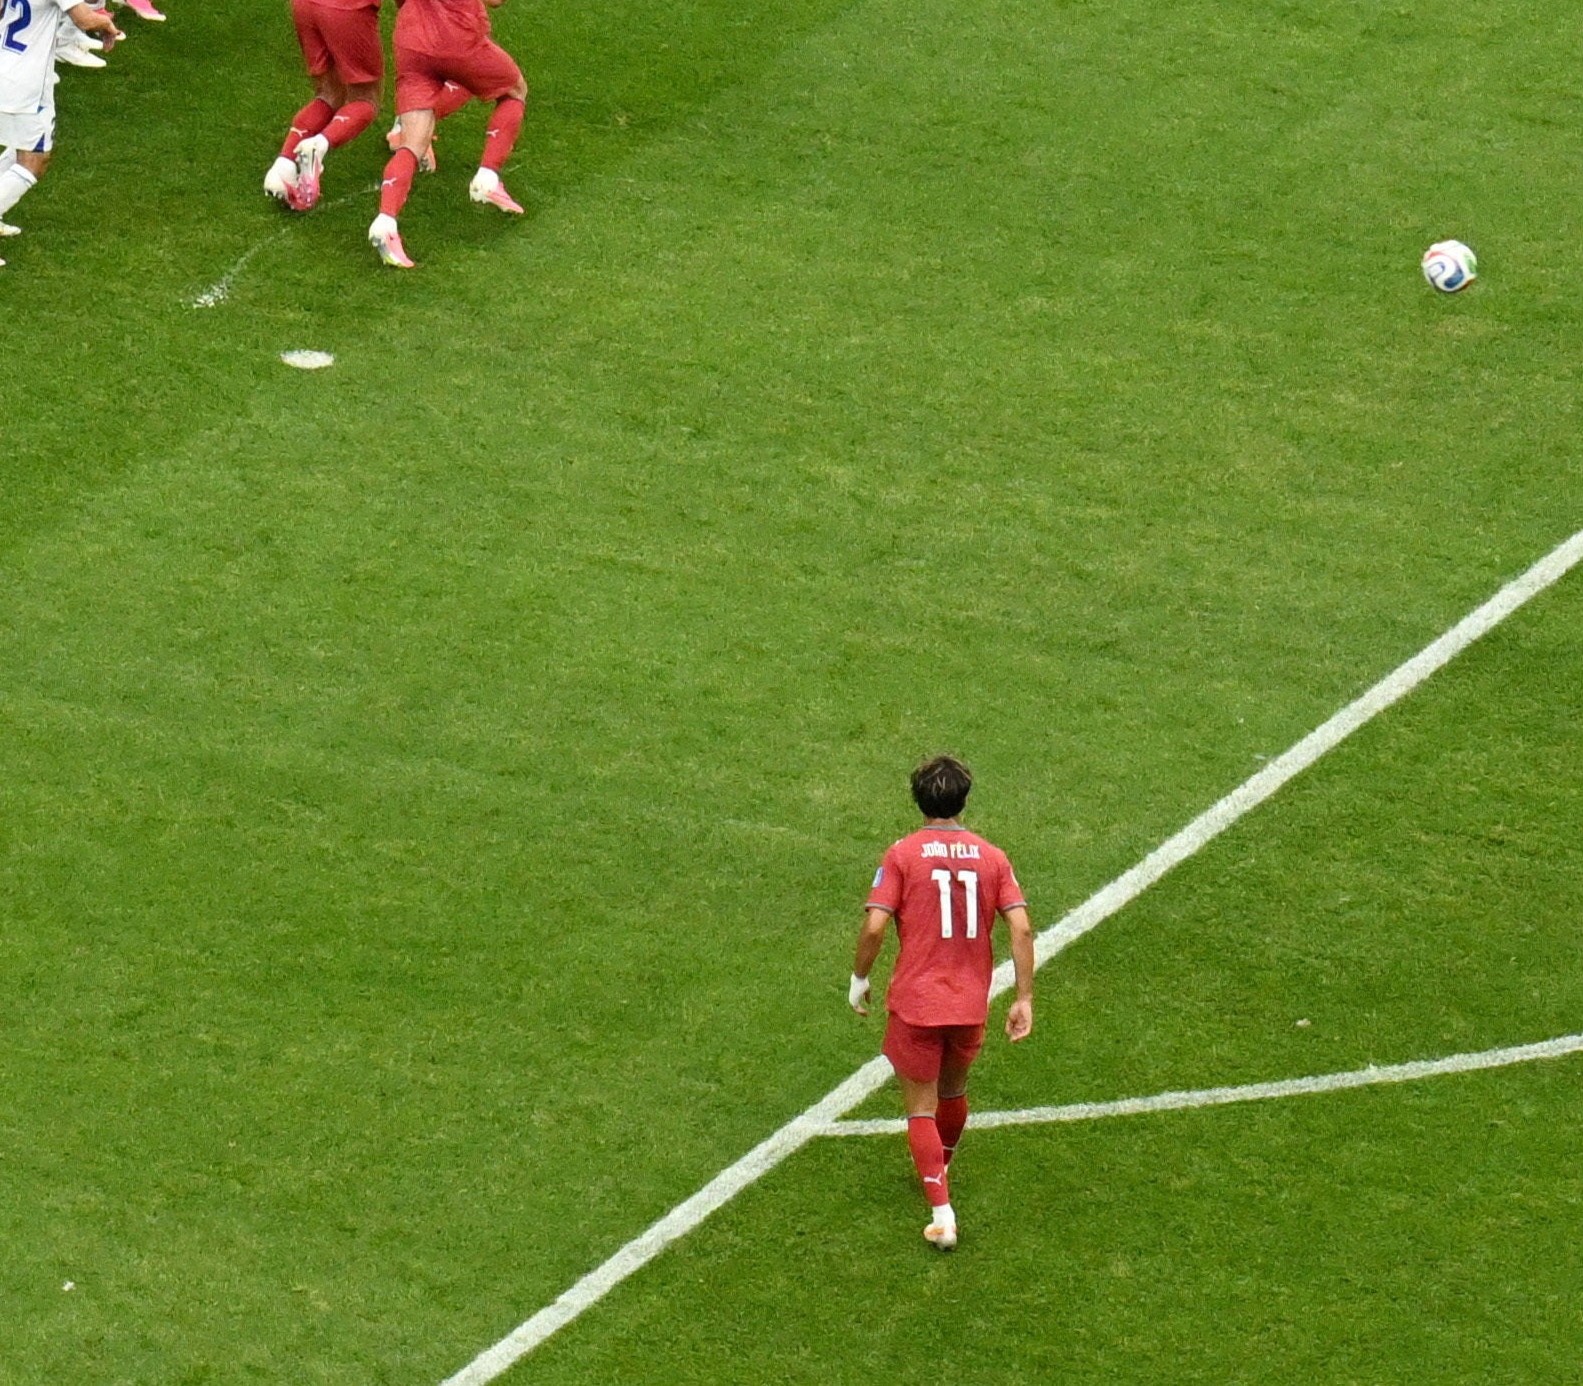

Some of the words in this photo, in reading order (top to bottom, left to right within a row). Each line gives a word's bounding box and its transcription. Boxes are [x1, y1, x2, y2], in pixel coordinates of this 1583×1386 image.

[920, 840, 948, 859] JOÃO
[949, 840, 981, 859] FÉLIX
[931, 868, 978, 939] 11
